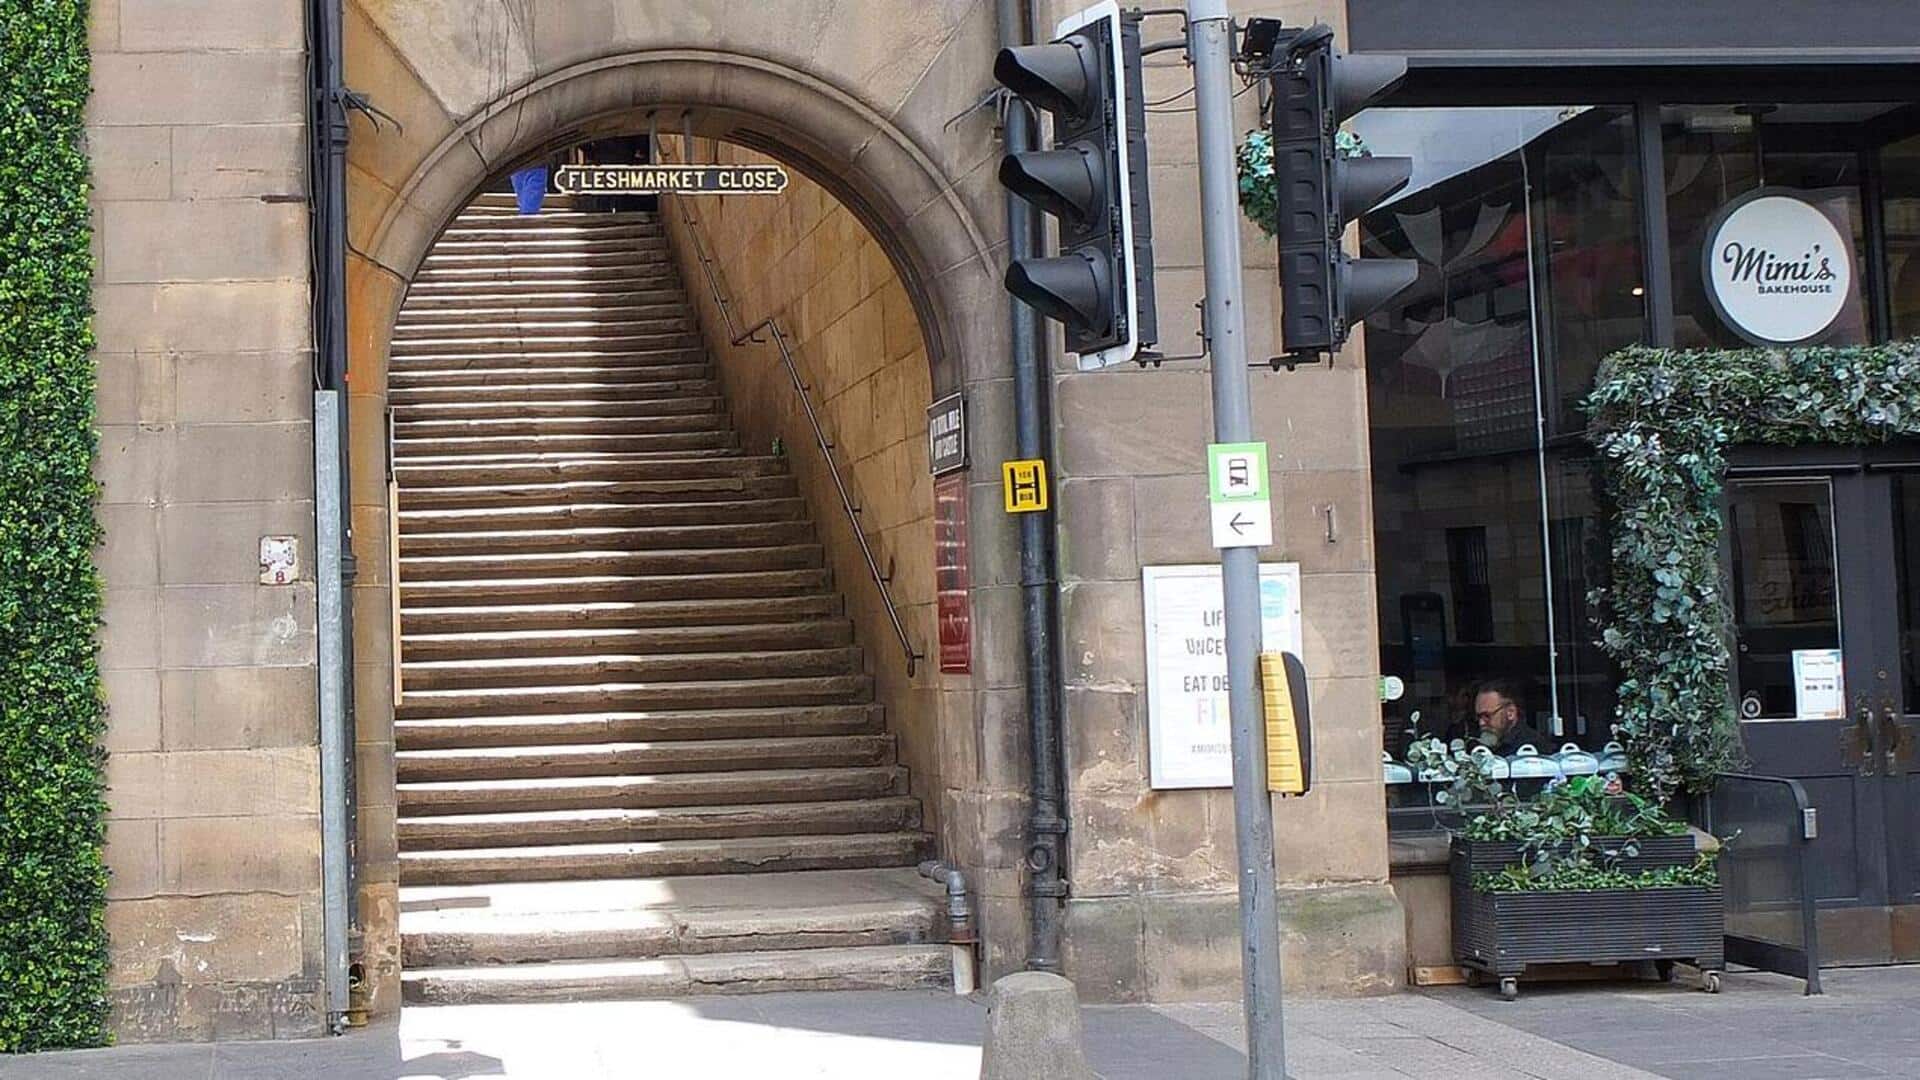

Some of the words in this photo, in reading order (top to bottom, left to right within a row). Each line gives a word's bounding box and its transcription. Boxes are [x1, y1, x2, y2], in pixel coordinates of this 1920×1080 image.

[568, 171, 705, 188] FLESHMARKET
[718, 171, 777, 188] CLOSE
[1723, 242, 1836, 284] Mimi's
[1758, 284, 1832, 294] BAKEHOUSE
[1203, 610, 1223, 627] LIF
[1185, 637, 1225, 655] UNCE
[1183, 675, 1207, 692] EAT
